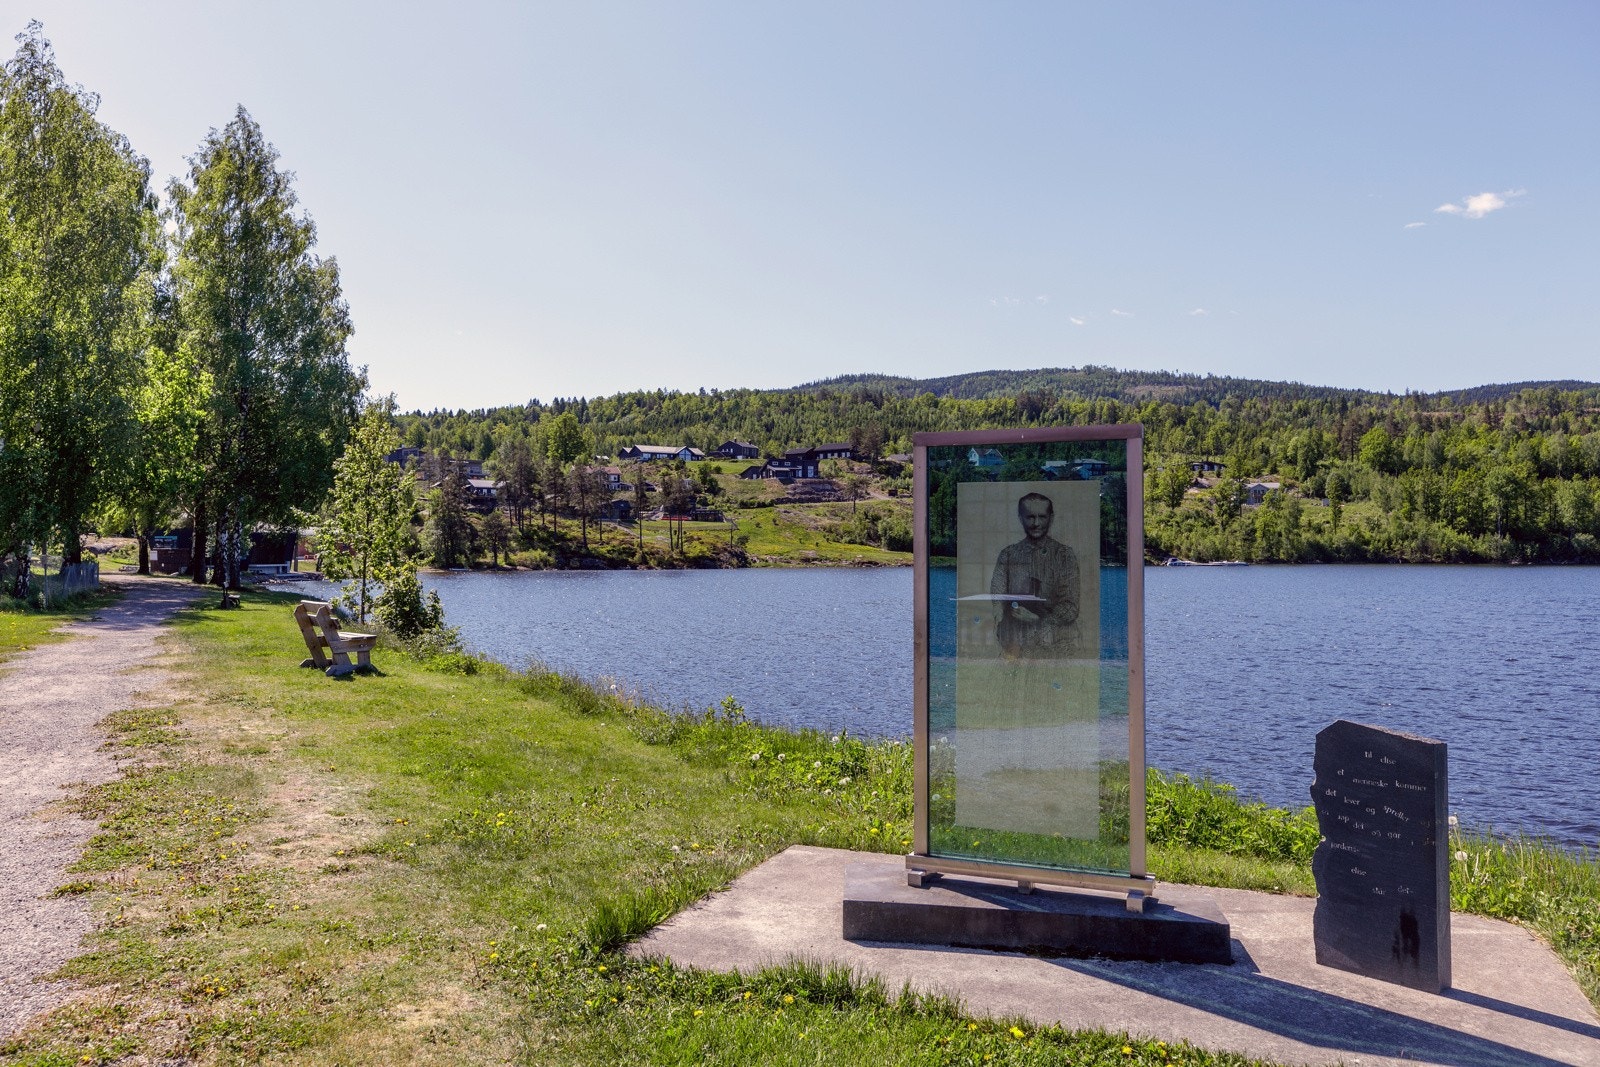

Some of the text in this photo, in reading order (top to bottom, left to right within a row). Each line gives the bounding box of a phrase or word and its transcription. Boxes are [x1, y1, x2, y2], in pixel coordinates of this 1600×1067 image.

[1364, 750, 1373, 759] til
[1395, 779, 1427, 792] kommer
[1365, 806, 1376, 816] og
